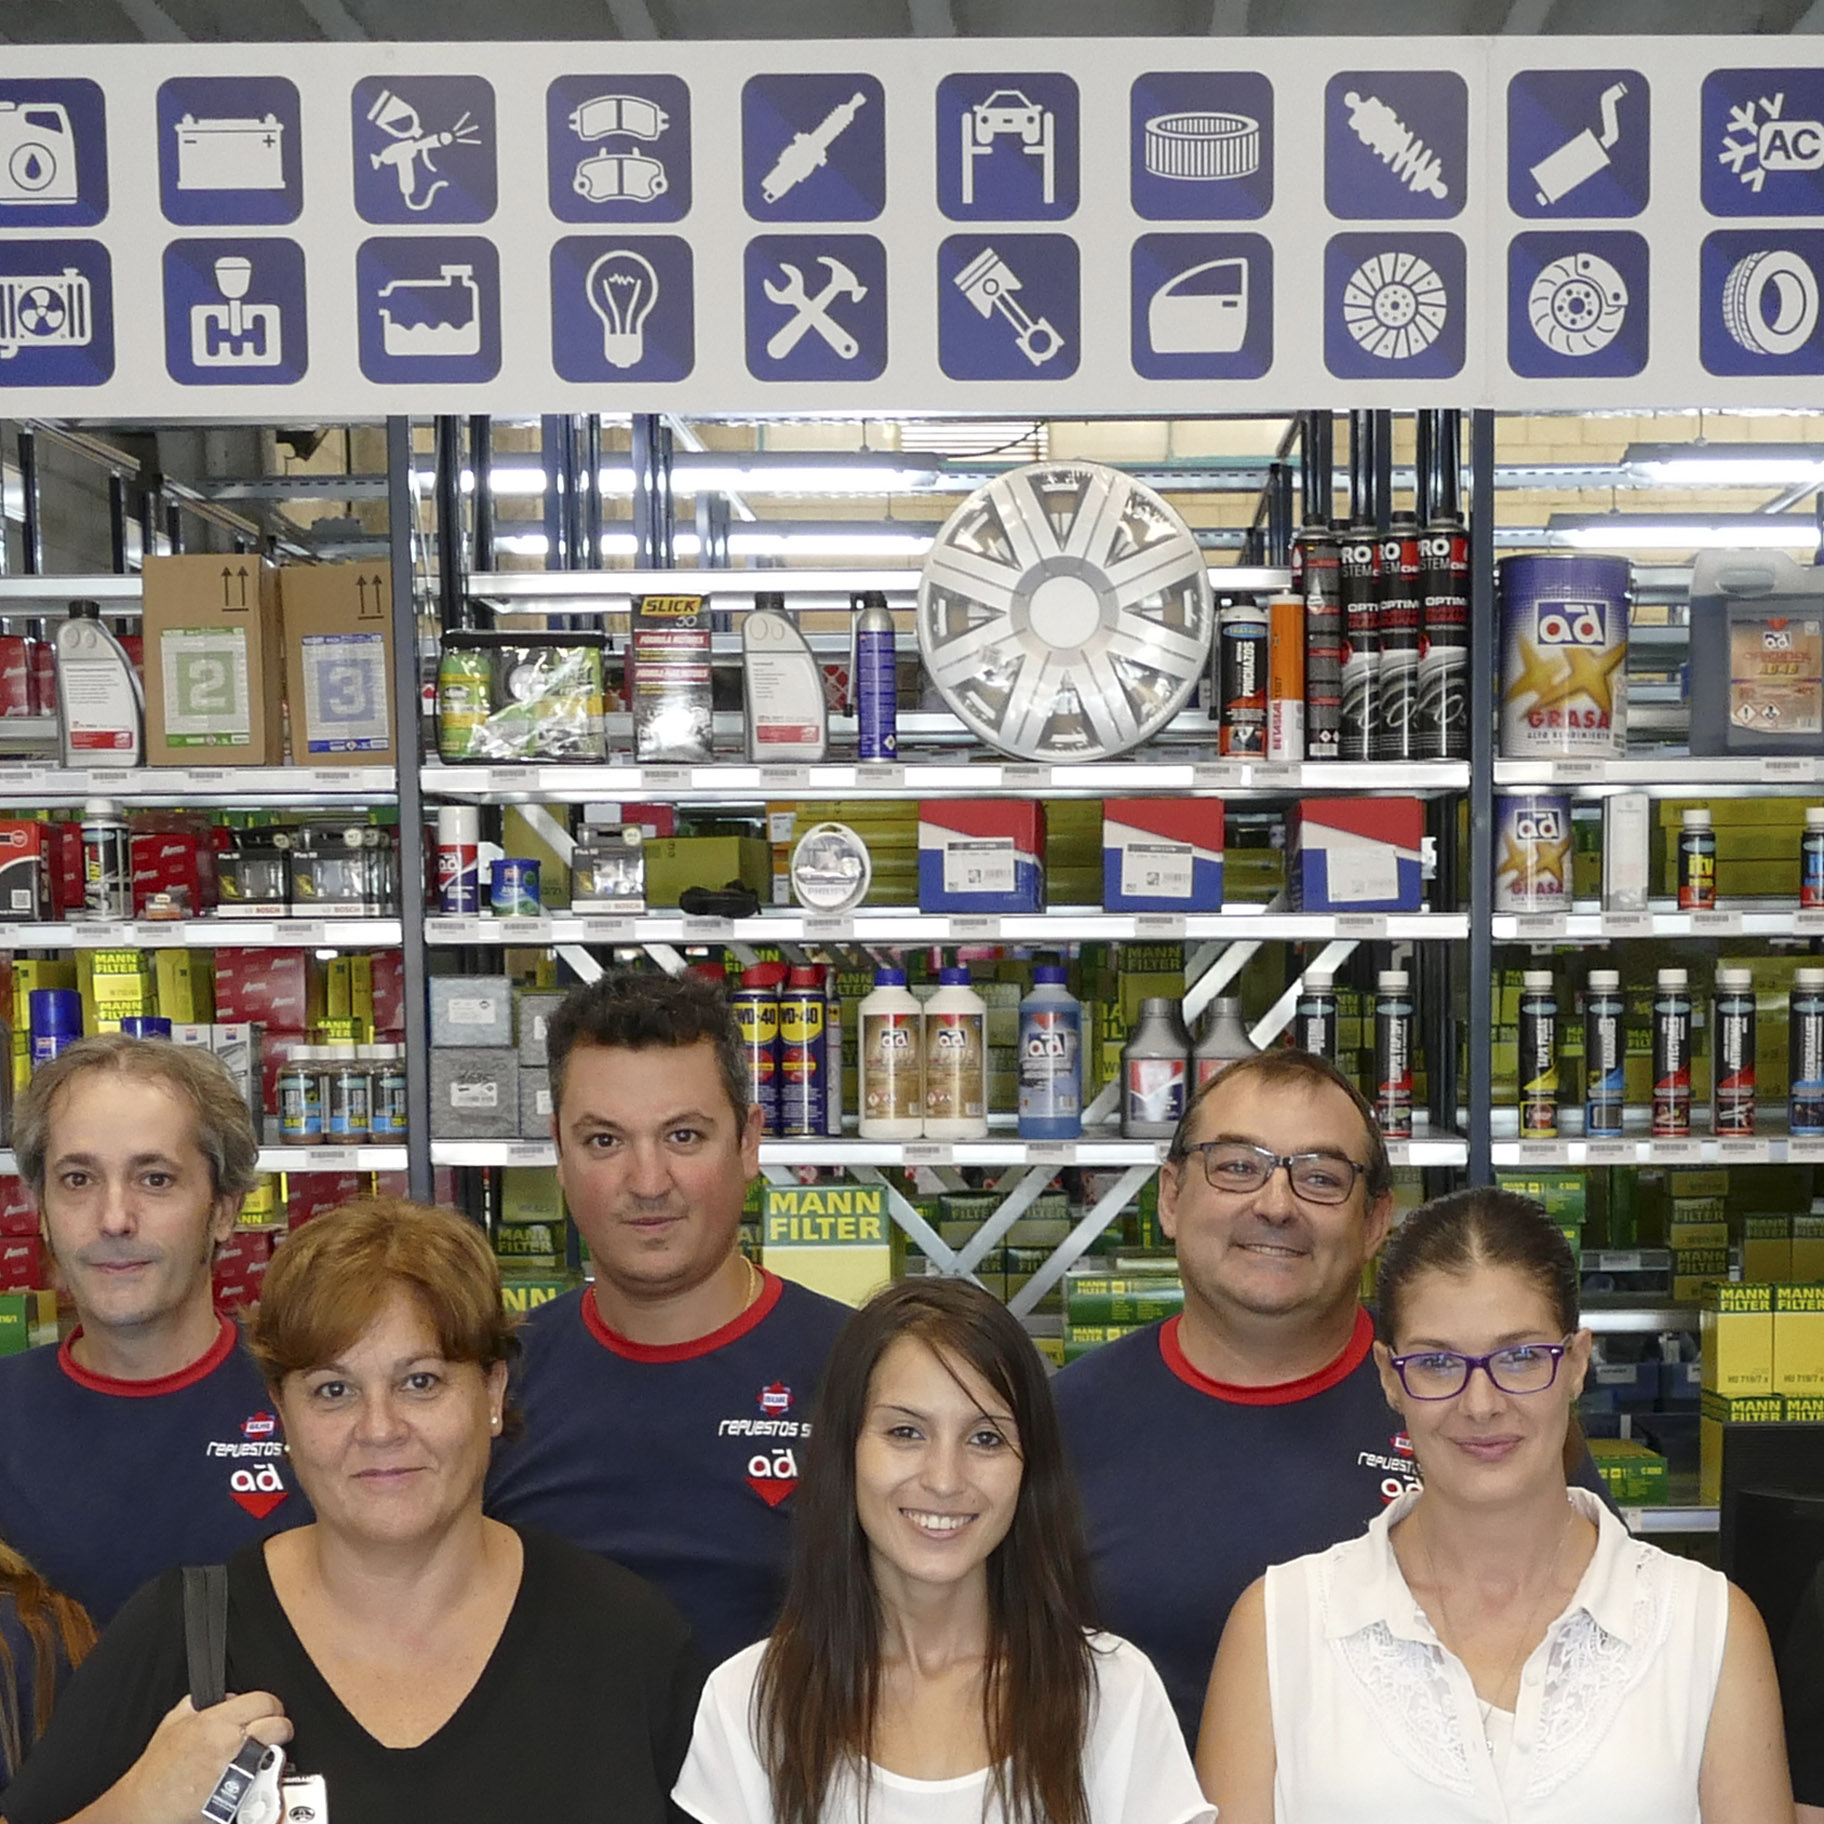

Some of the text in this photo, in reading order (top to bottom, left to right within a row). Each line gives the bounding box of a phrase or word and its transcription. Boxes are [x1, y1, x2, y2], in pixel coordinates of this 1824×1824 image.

[1765, 129, 1821, 160] AC
[646, 600, 697, 612] SLICK
[1540, 604, 1605, 643] ad
[189, 659, 226, 710] 2
[329, 666, 366, 714] 3
[1528, 709, 1610, 729] GRASA
[1518, 811, 1558, 839] ad
[808, 886, 848, 896] PHILIPS
[1512, 880, 1564, 895] GRASA
[95, 954, 137, 963] MANN
[1123, 947, 1180, 958] MANN
[95, 964, 137, 973] FILTER
[1124, 959, 1181, 970] FILTER
[100, 1002, 142, 1010] MANN
[100, 1011, 142, 1020] FILTER
[781, 1006, 817, 1025] WD-40
[882, 1030, 908, 1048] ad
[939, 1030, 966, 1048] ad
[1028, 1031, 1065, 1056] ad
[769, 1191, 881, 1215] MANN
[769, 1217, 882, 1240] FILTER
[1721, 1288, 1770, 1298] MANN
[1721, 1300, 1770, 1311] FILTER
[1731, 1401, 1781, 1410] MANN
[1731, 1412, 1781, 1420] FILTER
[748, 1449, 798, 1478] ad
[231, 1463, 284, 1491] ad
